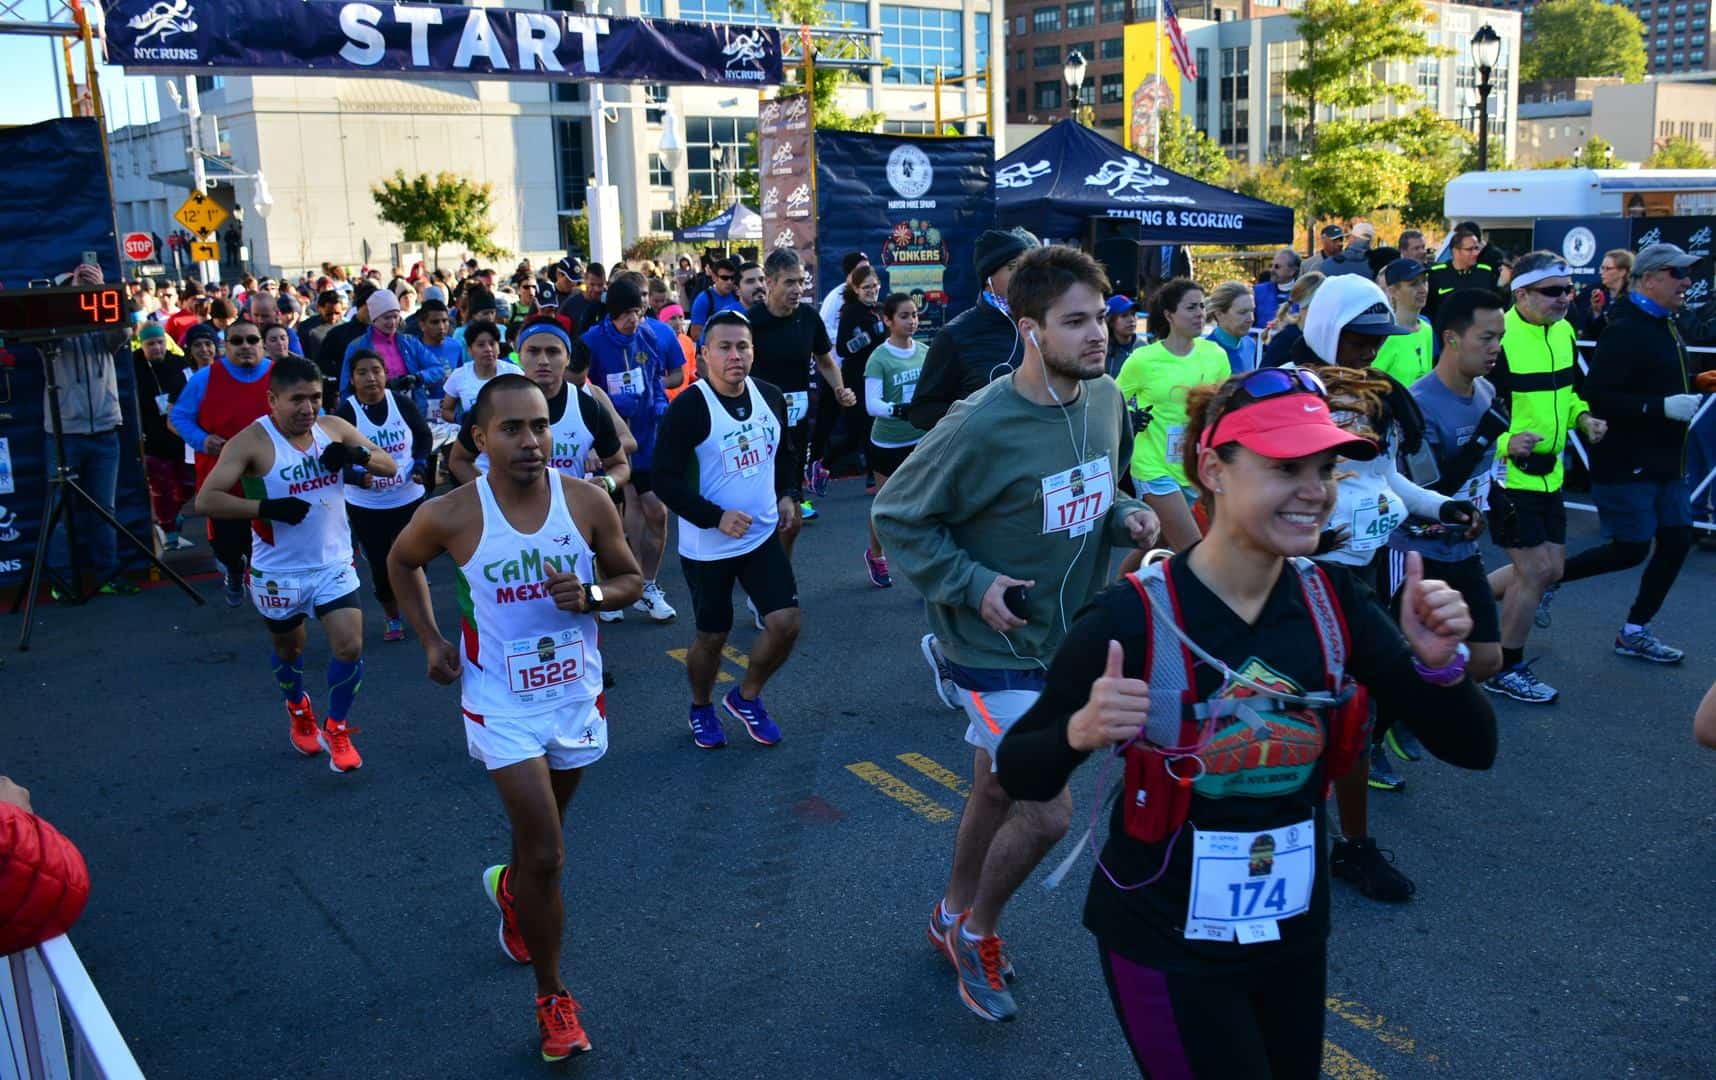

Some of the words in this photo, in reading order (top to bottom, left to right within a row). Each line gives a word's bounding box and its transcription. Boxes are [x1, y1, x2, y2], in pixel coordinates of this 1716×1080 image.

[339, 3, 610, 73] START
[134, 48, 198, 60] NYCRUNS
[1166, 212, 1177, 226] &
[1180, 212, 1244, 229] SCORING
[126, 241, 152, 253] STOP
[892, 249, 940, 261] YONKERS
[80, 290, 119, 323] 49
[280, 455, 328, 482] CAM
[734, 449, 760, 469] 1411
[289, 473, 338, 495] MEXICO
[1057, 492, 1103, 526] 1777
[1366, 513, 1399, 536] 465
[259, 595, 290, 608] 1187
[519, 658, 577, 689] 1522
[1228, 878, 1287, 917] 174
